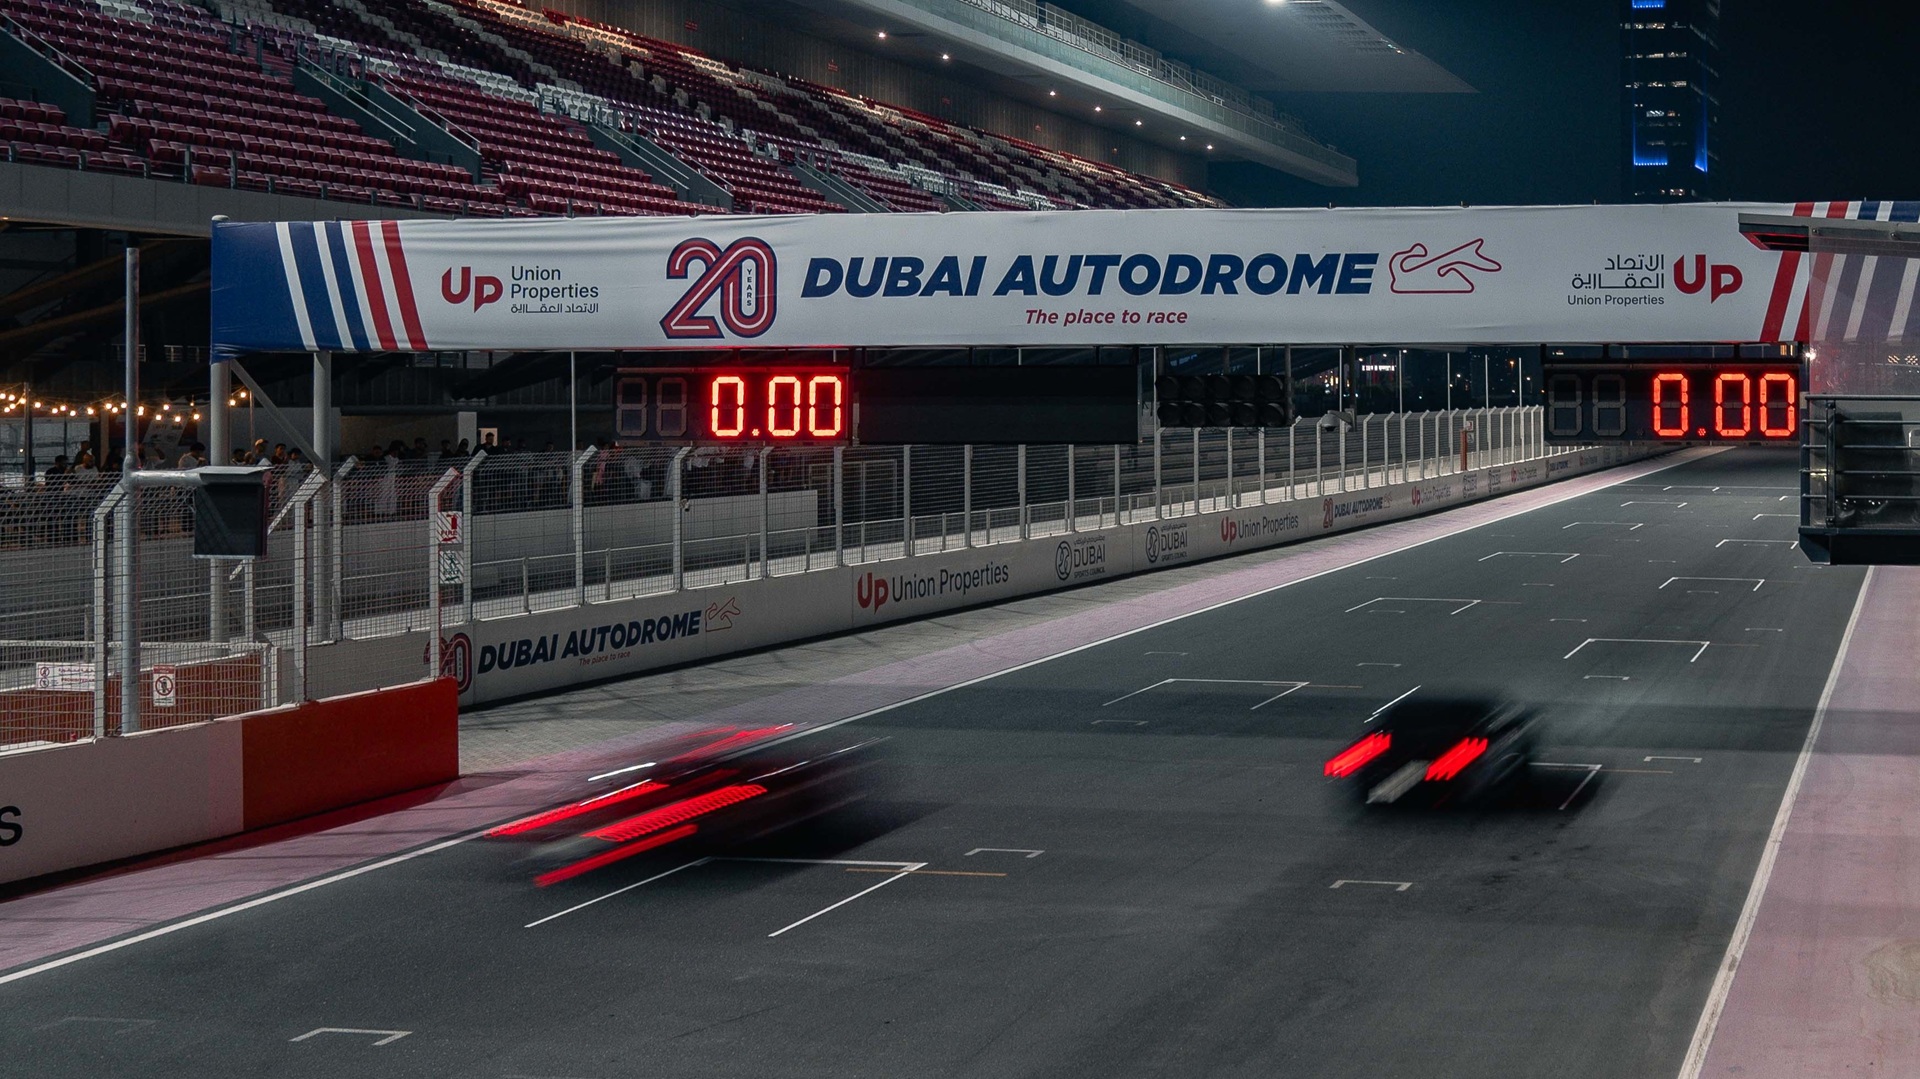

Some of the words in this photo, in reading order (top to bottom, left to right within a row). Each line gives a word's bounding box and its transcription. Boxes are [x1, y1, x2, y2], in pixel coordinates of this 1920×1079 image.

[511, 265, 561, 281] Union
[1604, 254, 1664, 271] الاتحاد
[800, 256, 987, 298] DUBAI
[992, 253, 1380, 296] AUTODROME
[511, 283, 599, 301] Properties
[659, 236, 778, 339] 20
[1567, 294, 1601, 305] Union
[1604, 294, 1665, 307] Properties
[1026, 309, 1058, 324] The
[1063, 309, 1116, 327] place
[1121, 309, 1141, 324] to
[1146, 311, 1188, 324] race
[711, 376, 842, 437] 0.00
[1653, 373, 1795, 437] 0.00
[1323, 498, 1334, 528] 20
[1334, 502, 1351, 518] DUBAI
[1351, 497, 1383, 514] AUTODROME
[1238, 519, 1261, 539] Union
[1263, 512, 1299, 536] Properties
[1161, 530, 1188, 551] DUBAI
[1074, 544, 1106, 567] DUBAI
[891, 573, 936, 602] Union
[939, 561, 1009, 596] Properties
[477, 633, 560, 675] DUBAI
[561, 610, 702, 659] AUTODROME
[591, 655, 609, 665] place
[610, 653, 617, 661] to
[617, 651, 631, 659] race
